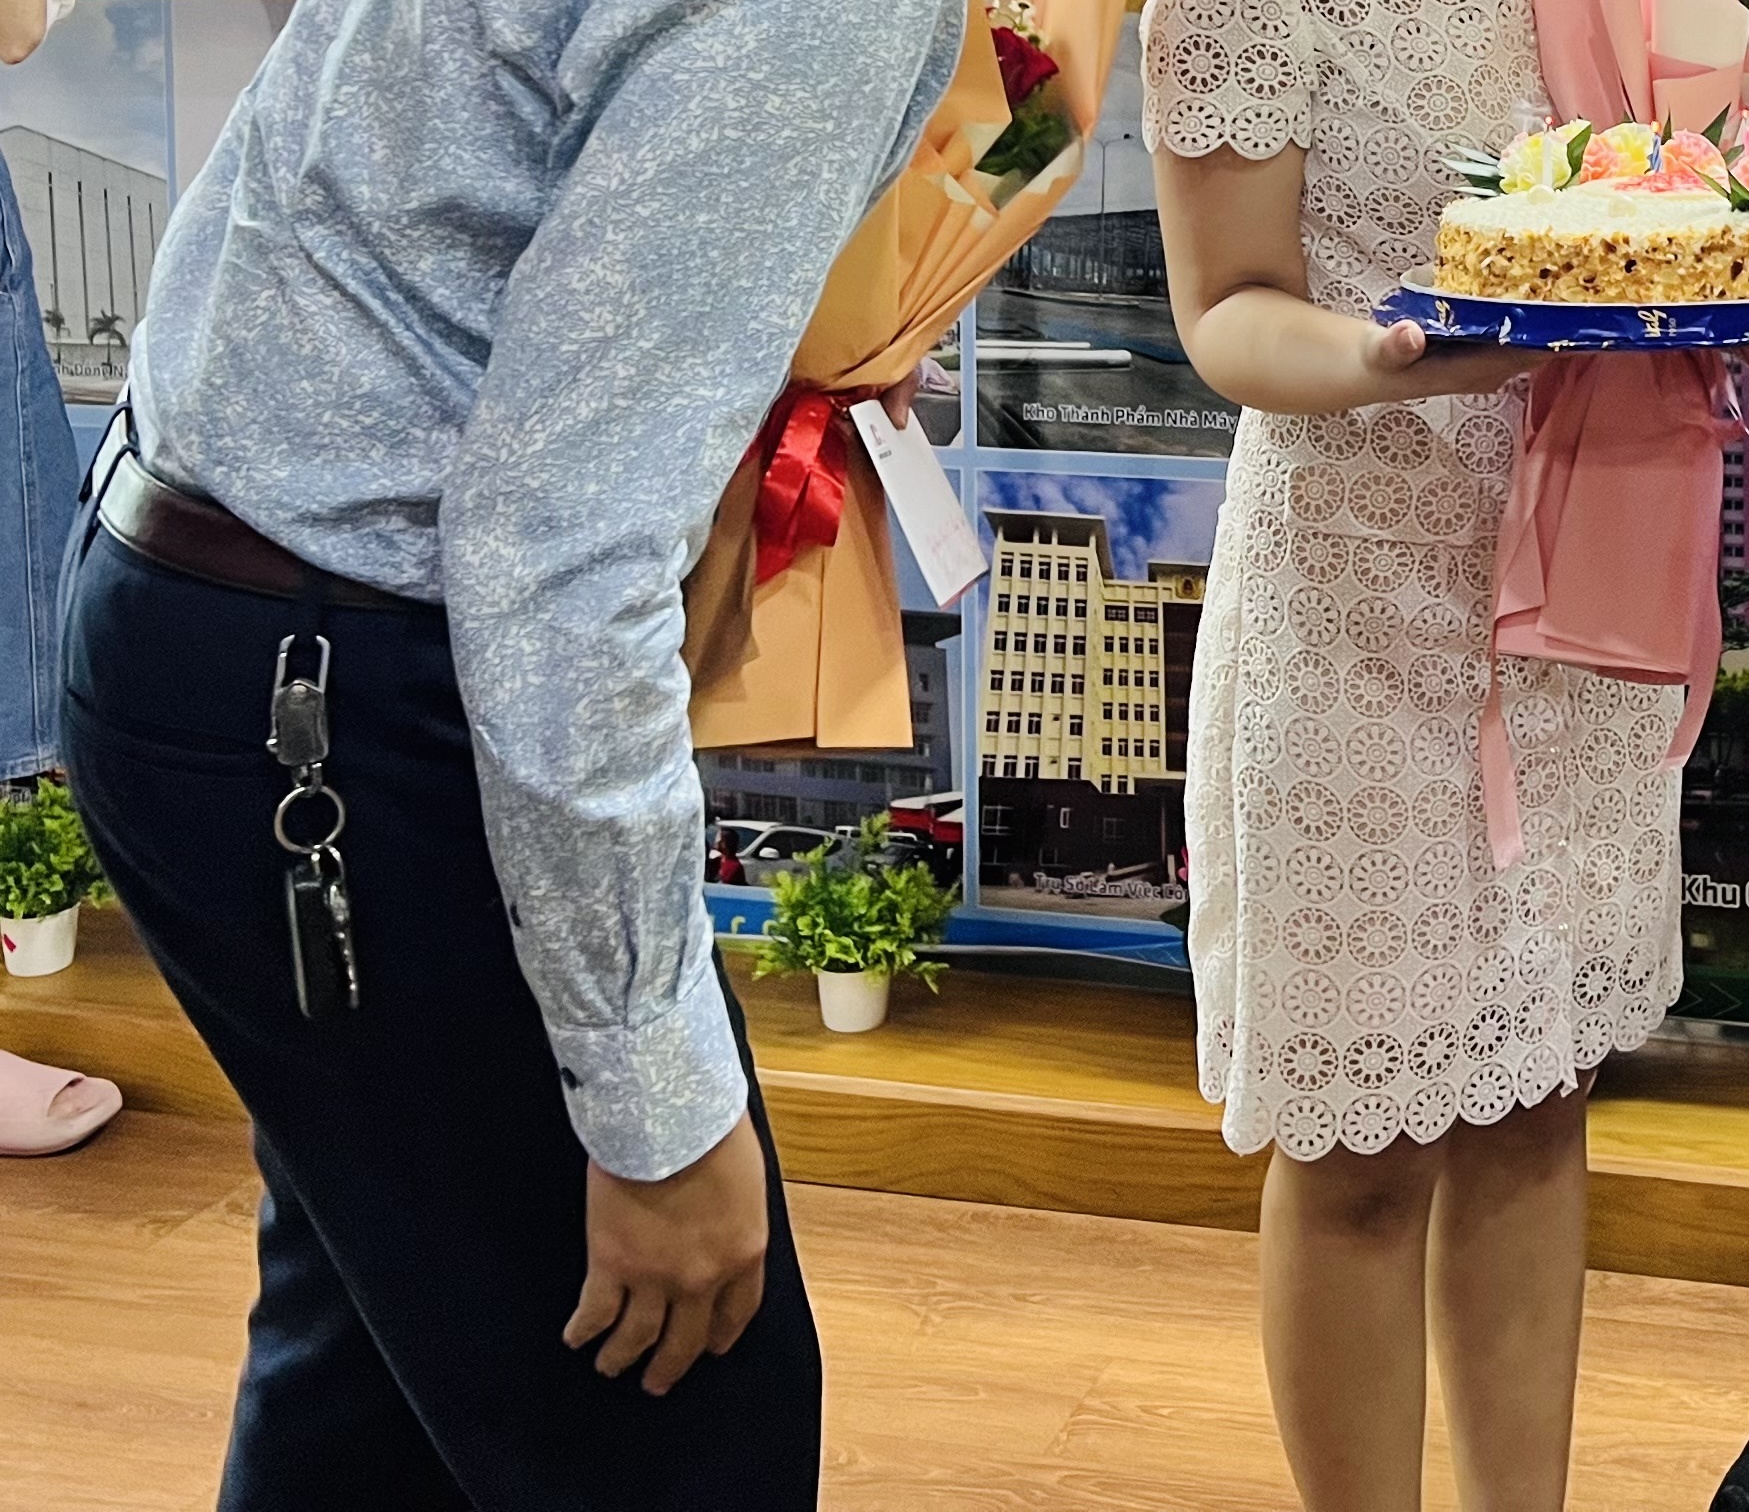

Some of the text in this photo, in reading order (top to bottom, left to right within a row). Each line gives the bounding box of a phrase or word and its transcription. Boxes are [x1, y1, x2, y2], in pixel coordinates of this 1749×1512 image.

[1024, 403, 1055, 422] Kho
[1059, 405, 1111, 425] Thành
[1165, 409, 1198, 428] Nhà
[1681, 875, 1740, 908] Khu
